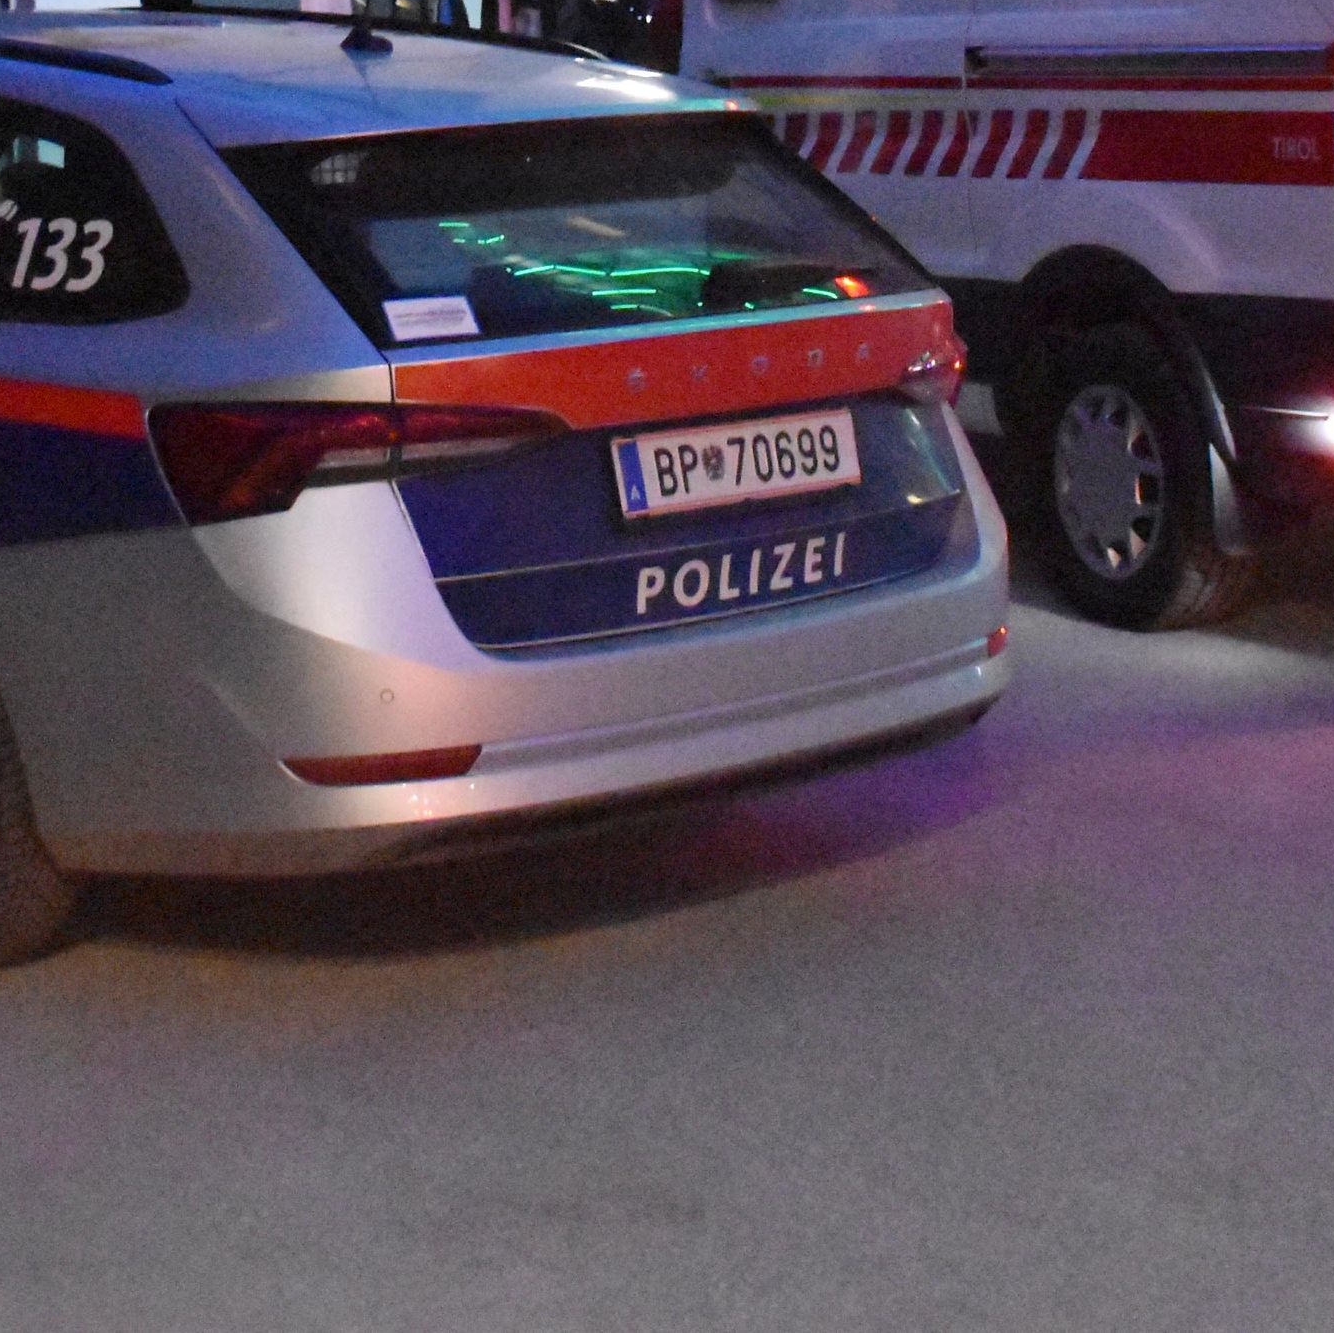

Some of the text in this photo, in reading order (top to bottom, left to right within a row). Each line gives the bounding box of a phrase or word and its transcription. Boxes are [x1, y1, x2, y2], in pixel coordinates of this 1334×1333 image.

[1273, 137, 1322, 159] TIROL
[10, 216, 114, 293] 133
[652, 424, 841, 498] BP 70699
[635, 531, 848, 614] POLIZEI
